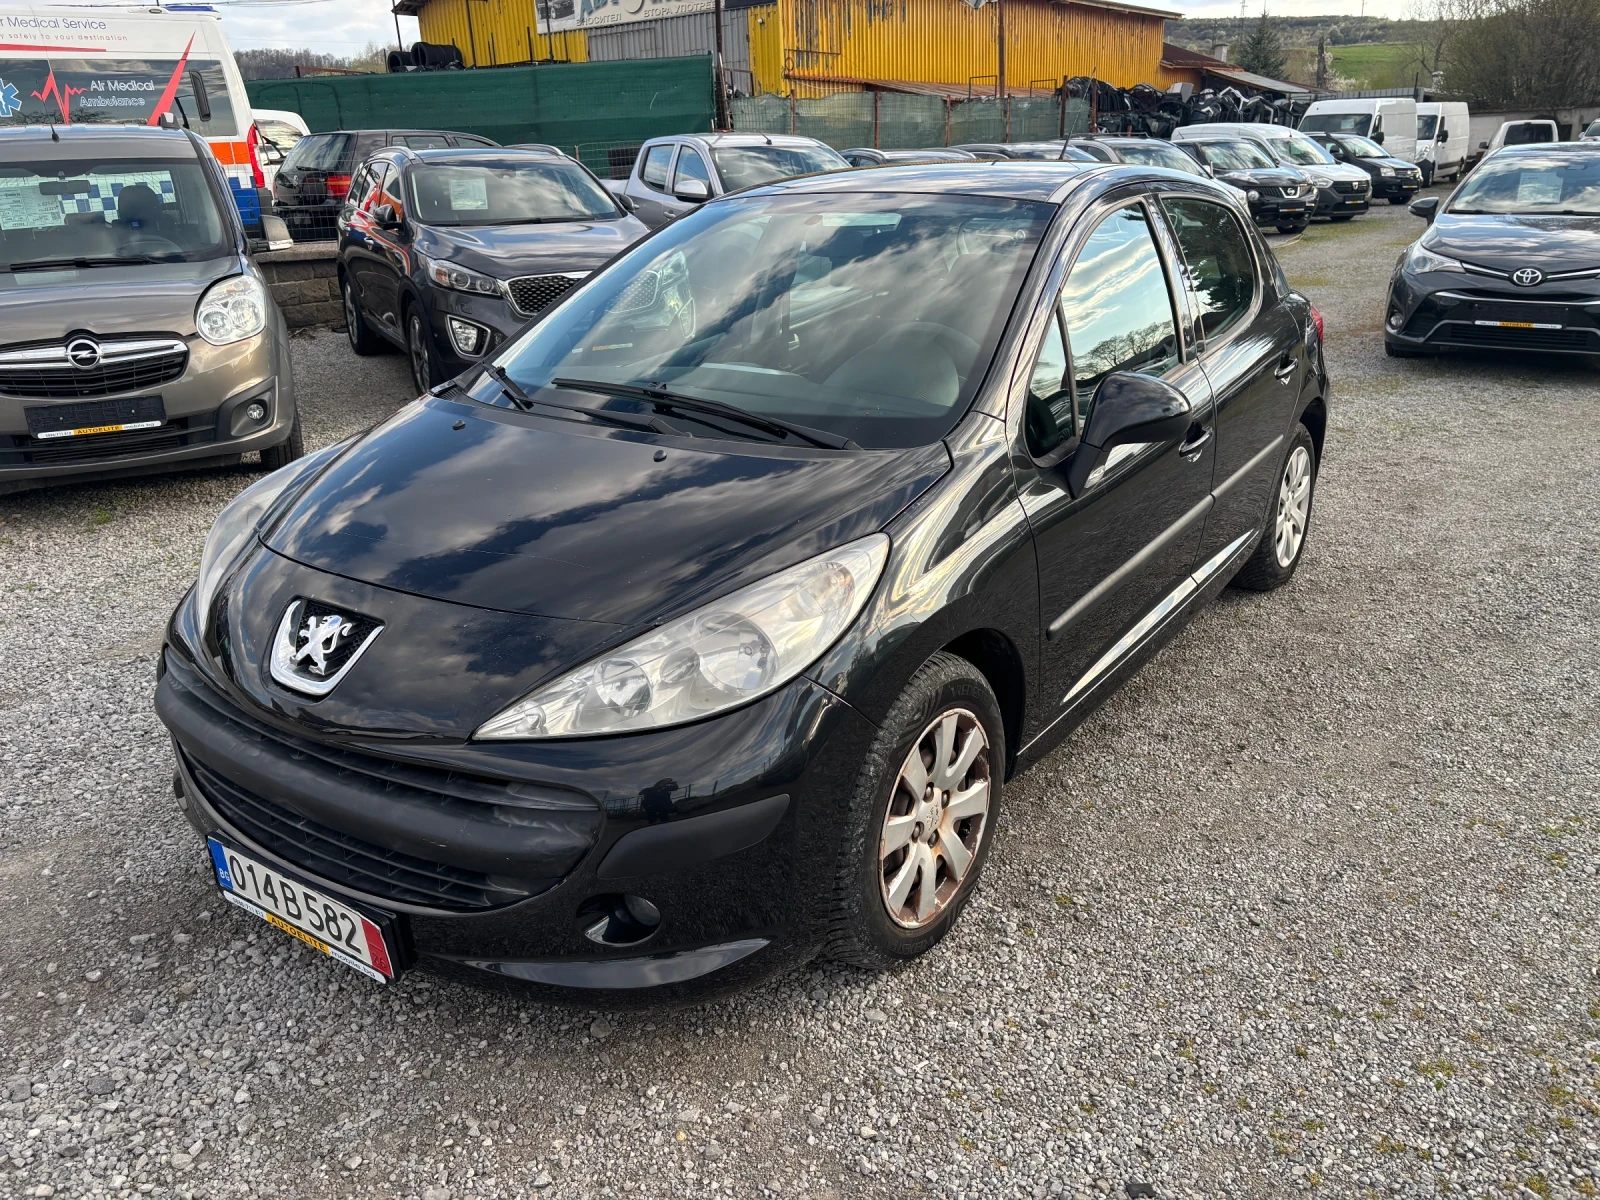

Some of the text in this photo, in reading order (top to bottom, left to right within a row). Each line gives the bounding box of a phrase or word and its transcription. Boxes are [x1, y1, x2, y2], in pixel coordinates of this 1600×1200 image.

[643, 7, 673, 18] ВТОРА
[675, 1, 725, 14] УПОТРЕБ
[6, 17, 60, 29] Medical
[62, 18, 107, 30] Service
[77, 34, 128, 42] destination
[90, 80, 155, 92] Air Medical
[80, 96, 146, 107] Ambulance
[219, 867, 231, 882] BG
[229, 855, 362, 954] 014B582
[270, 916, 326, 951] AUTOELITE
